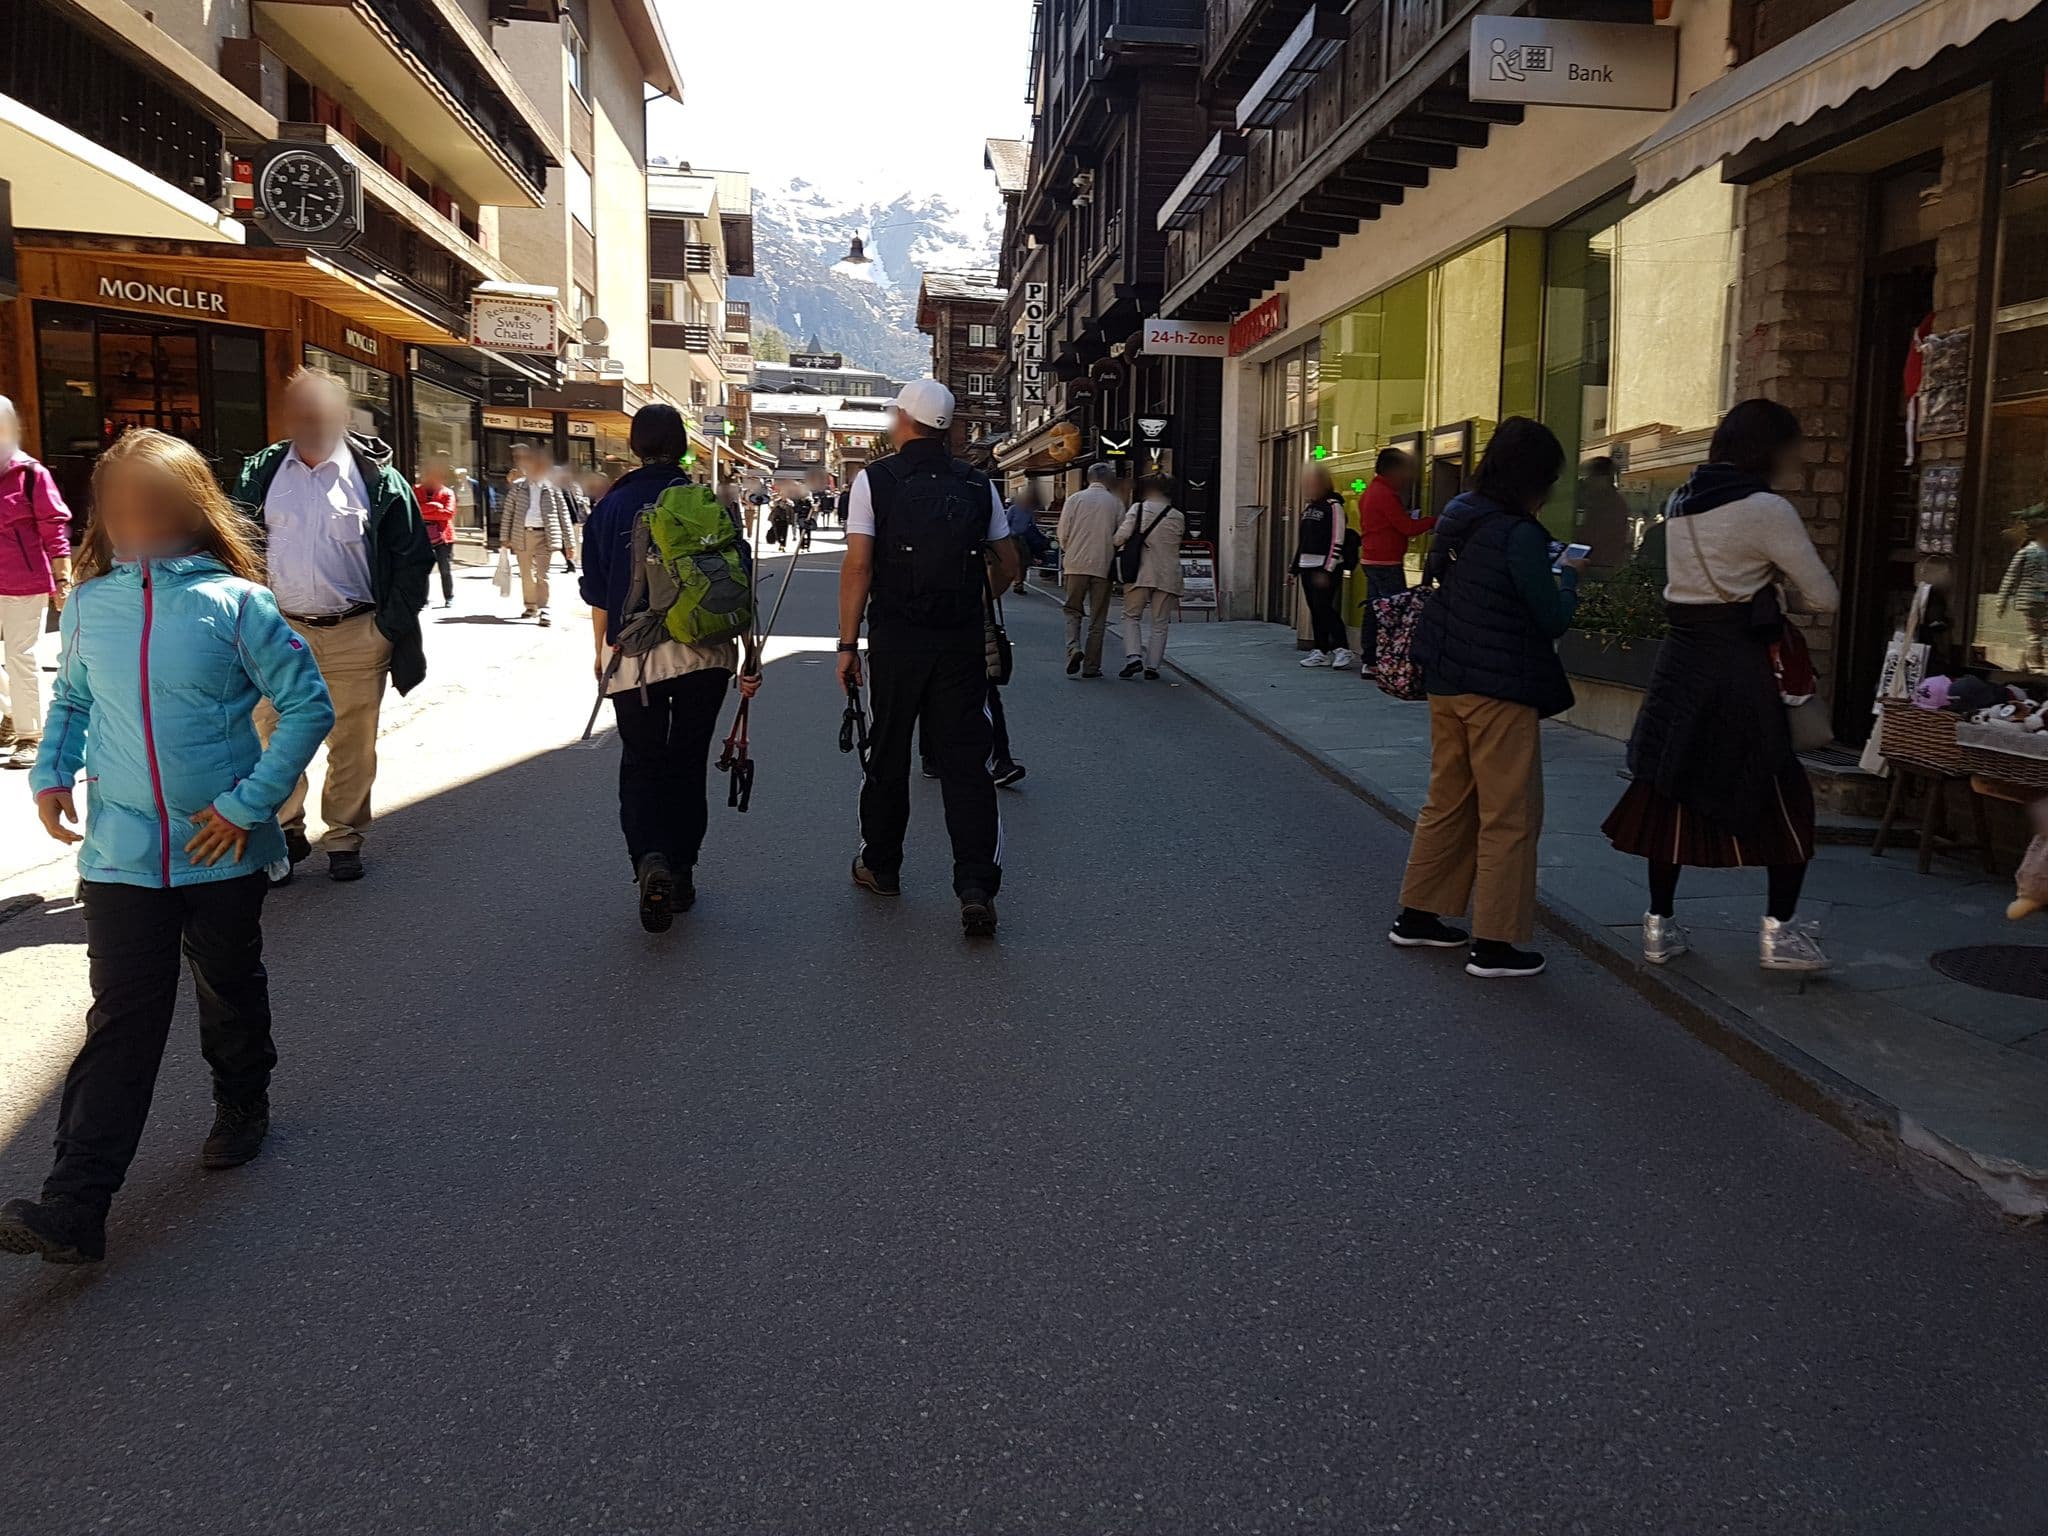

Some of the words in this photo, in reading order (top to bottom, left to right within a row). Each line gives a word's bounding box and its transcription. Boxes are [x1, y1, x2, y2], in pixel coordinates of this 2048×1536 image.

[1569, 63, 1613, 82] Bank
[100, 277, 227, 313] MONCLER
[485, 305, 543, 323] Restaurant
[497, 317, 532, 330] Swiss
[494, 328, 535, 341] Chalet
[1025, 284, 1042, 401] POLLUX
[1151, 331, 1225, 345] 24-h-Zone
[574, 424, 588, 434] pb
